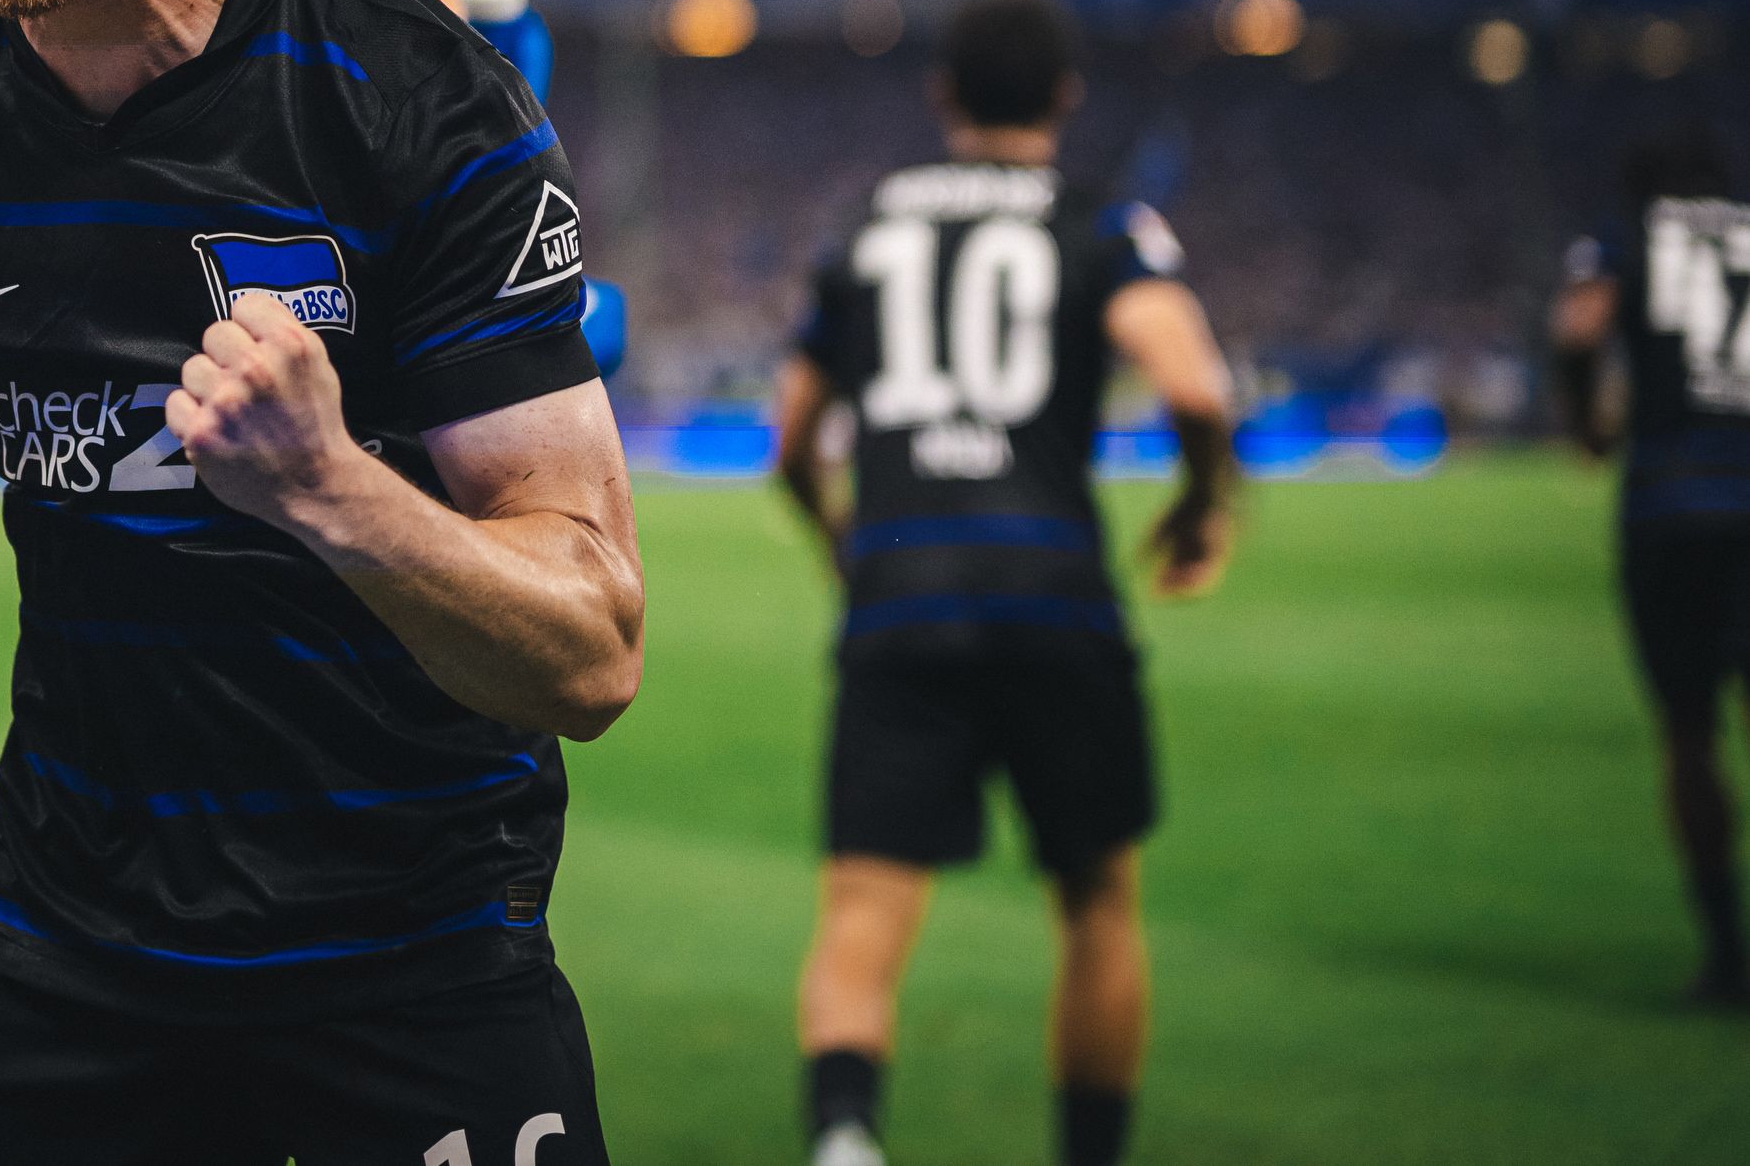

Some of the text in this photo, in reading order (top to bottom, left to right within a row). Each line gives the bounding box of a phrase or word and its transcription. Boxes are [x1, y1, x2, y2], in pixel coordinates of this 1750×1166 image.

[539, 217, 580, 271] WTG
[853, 216, 1062, 432] 10
[0, 430, 106, 493] CARS
